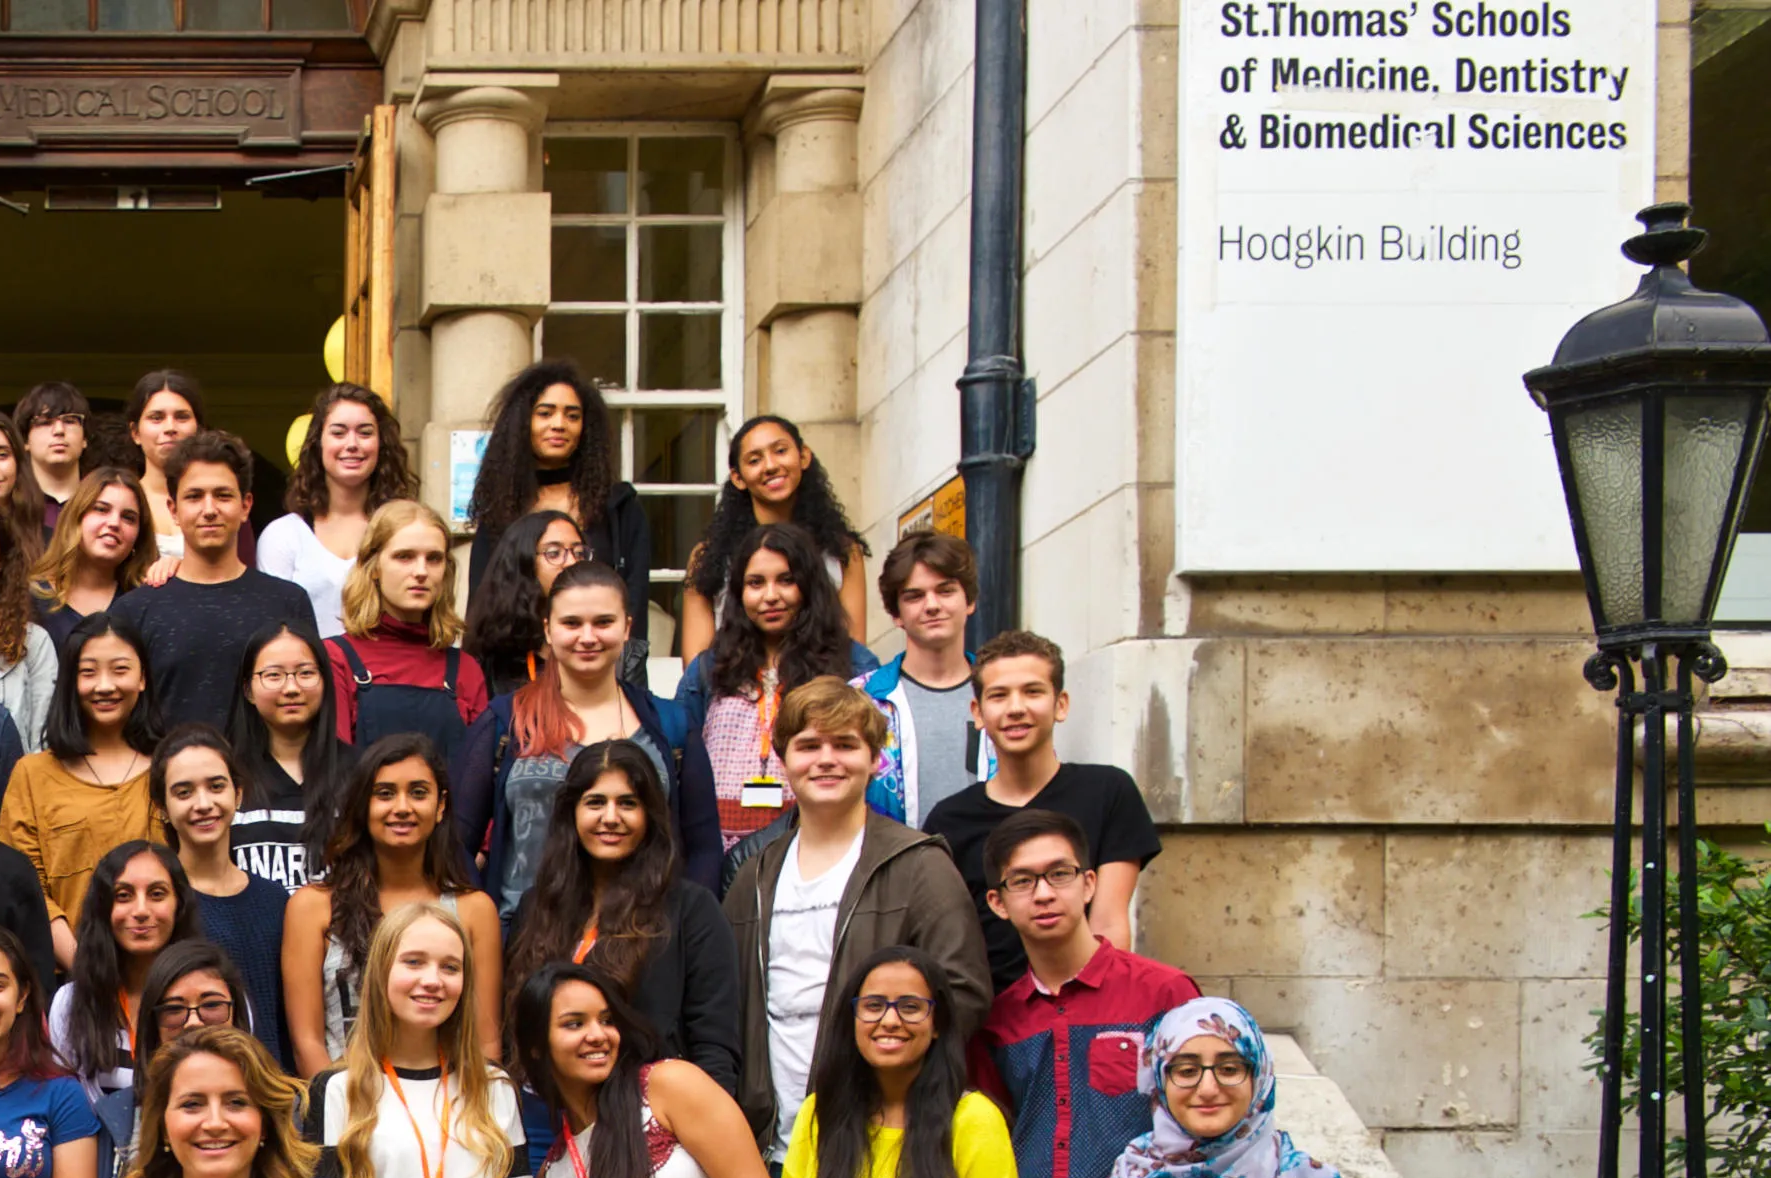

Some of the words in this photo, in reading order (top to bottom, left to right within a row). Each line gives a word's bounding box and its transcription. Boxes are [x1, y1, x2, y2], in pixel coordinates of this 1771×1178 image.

[1431, 1, 1571, 37] Schools
[1220, 57, 1258, 93] of
[1455, 57, 1629, 101] Dentistry
[145, 83, 286, 121] SCHOOL
[1220, 113, 1247, 149] &
[1259, 113, 1455, 149] Biomedical
[1467, 113, 1628, 150] Sciences
[1218, 225, 1365, 269] Hodgkin
[1379, 225, 1522, 269] Building
